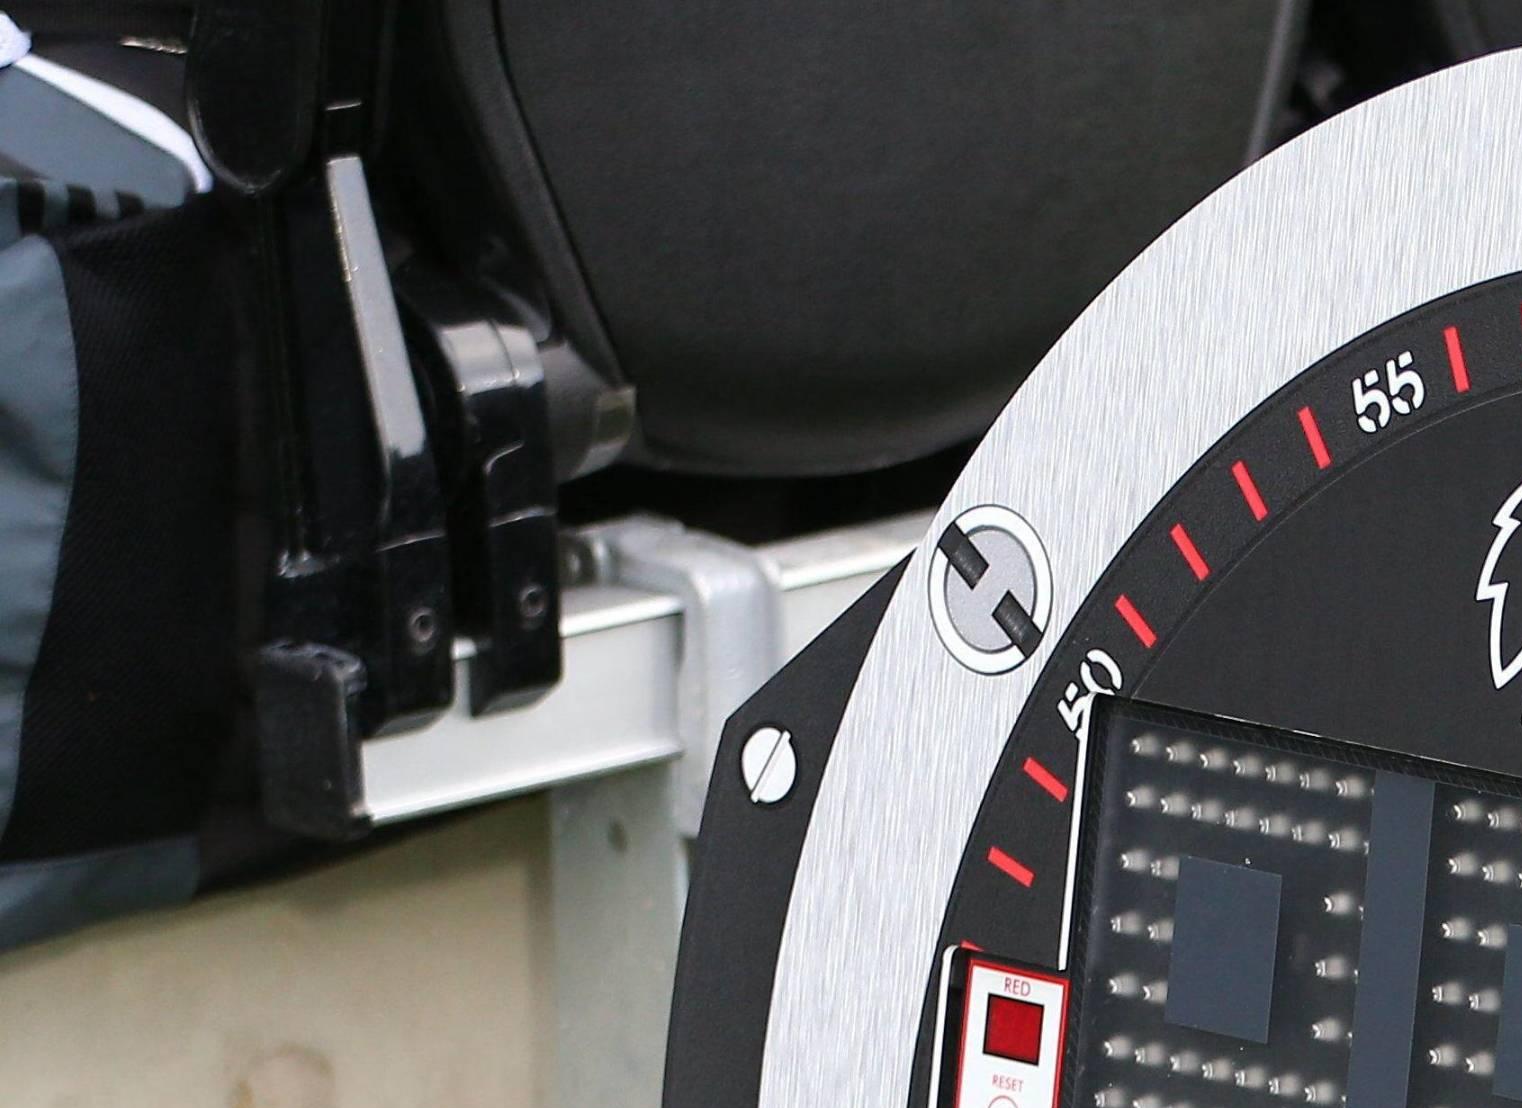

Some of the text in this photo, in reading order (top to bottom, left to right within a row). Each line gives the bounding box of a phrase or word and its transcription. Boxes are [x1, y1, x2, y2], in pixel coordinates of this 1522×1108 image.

[1352, 350, 1425, 433] 55
[1004, 977, 1032, 997] RED
[991, 1073, 1024, 1093] RESET
